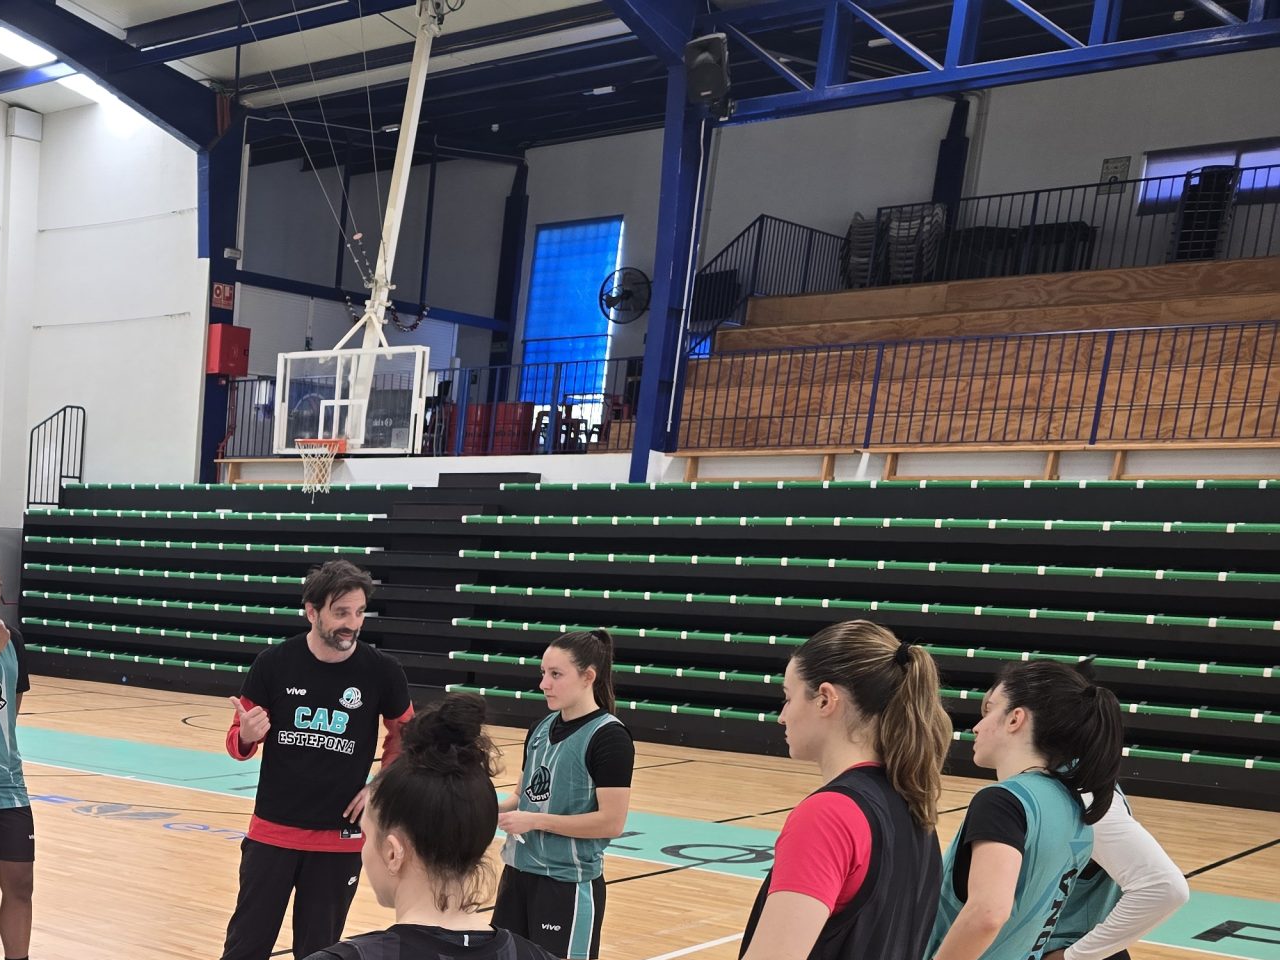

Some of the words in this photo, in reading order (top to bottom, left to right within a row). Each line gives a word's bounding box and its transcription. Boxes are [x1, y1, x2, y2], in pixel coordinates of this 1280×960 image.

[286, 687, 307, 696] vive
[294, 706, 350, 735] CAB
[278, 730, 356, 755] ESTEPONA
[541, 923, 561, 932] vive
